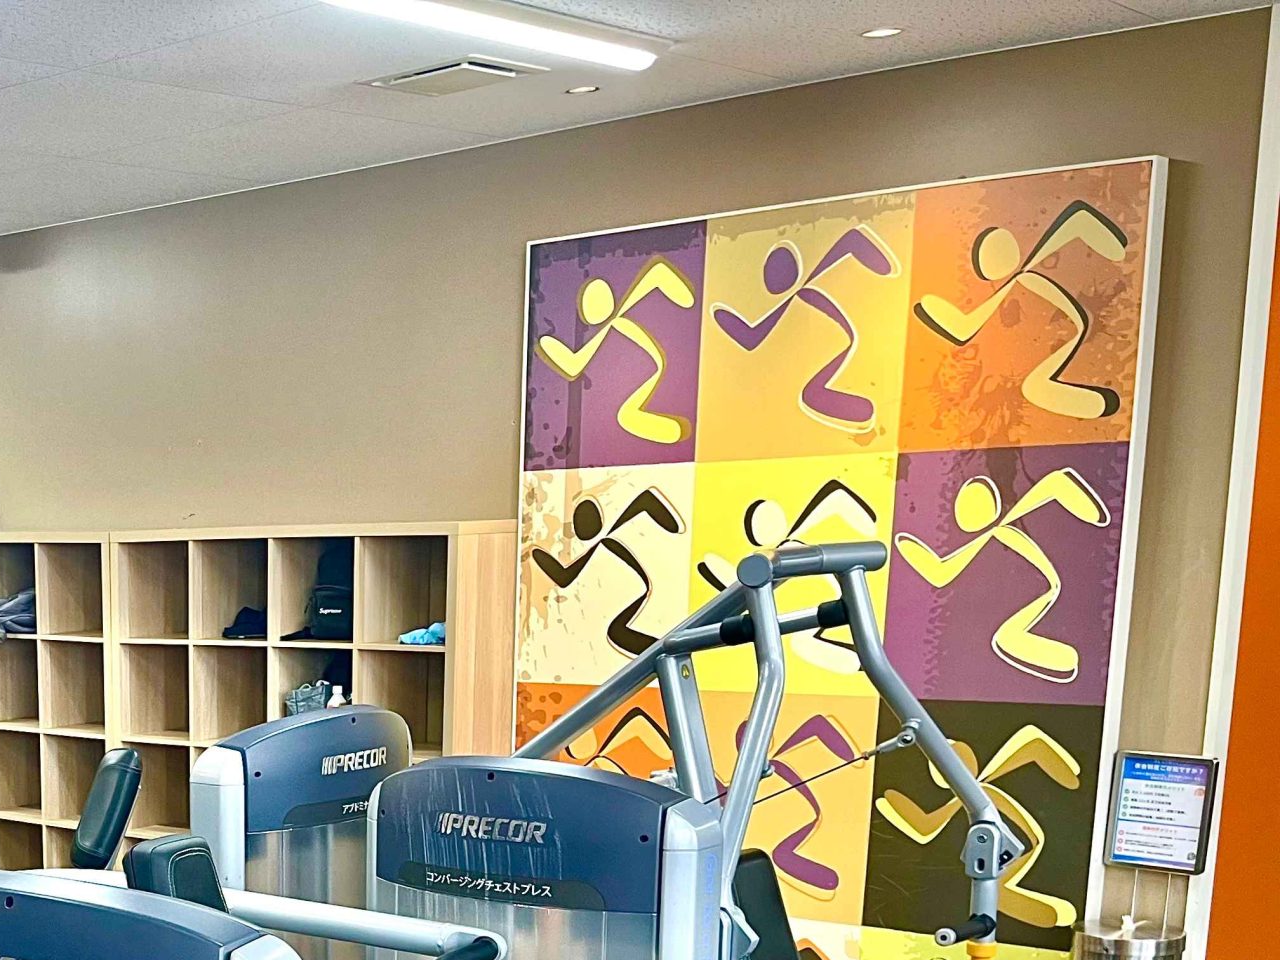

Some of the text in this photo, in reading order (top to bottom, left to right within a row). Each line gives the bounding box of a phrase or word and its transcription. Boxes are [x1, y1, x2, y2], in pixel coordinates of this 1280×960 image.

[330, 747, 387, 774] PRECOR
[342, 801, 369, 814] アブドミナ
[442, 813, 547, 844] PRECOR
[426, 871, 552, 897] コンバージングチェストプレス
